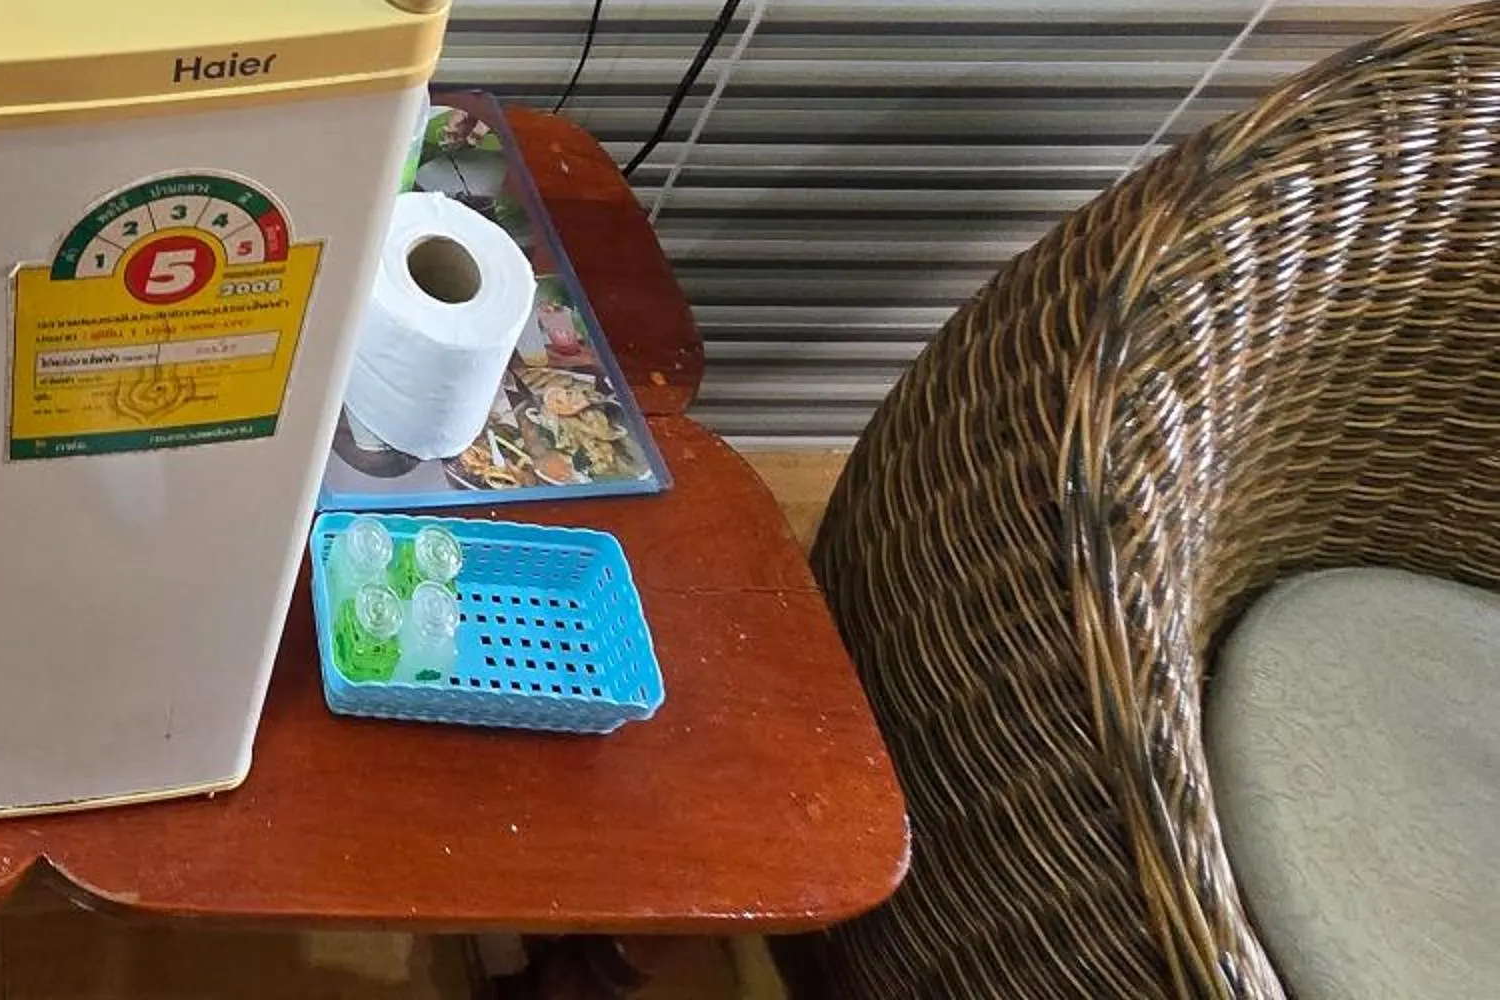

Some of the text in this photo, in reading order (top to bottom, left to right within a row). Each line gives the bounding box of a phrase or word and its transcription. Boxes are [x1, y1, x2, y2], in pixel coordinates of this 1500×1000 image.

[173, 52, 277, 83] Haier
[95, 204, 253, 268] 1 2 3 4 5
[145, 250, 197, 295] 5
